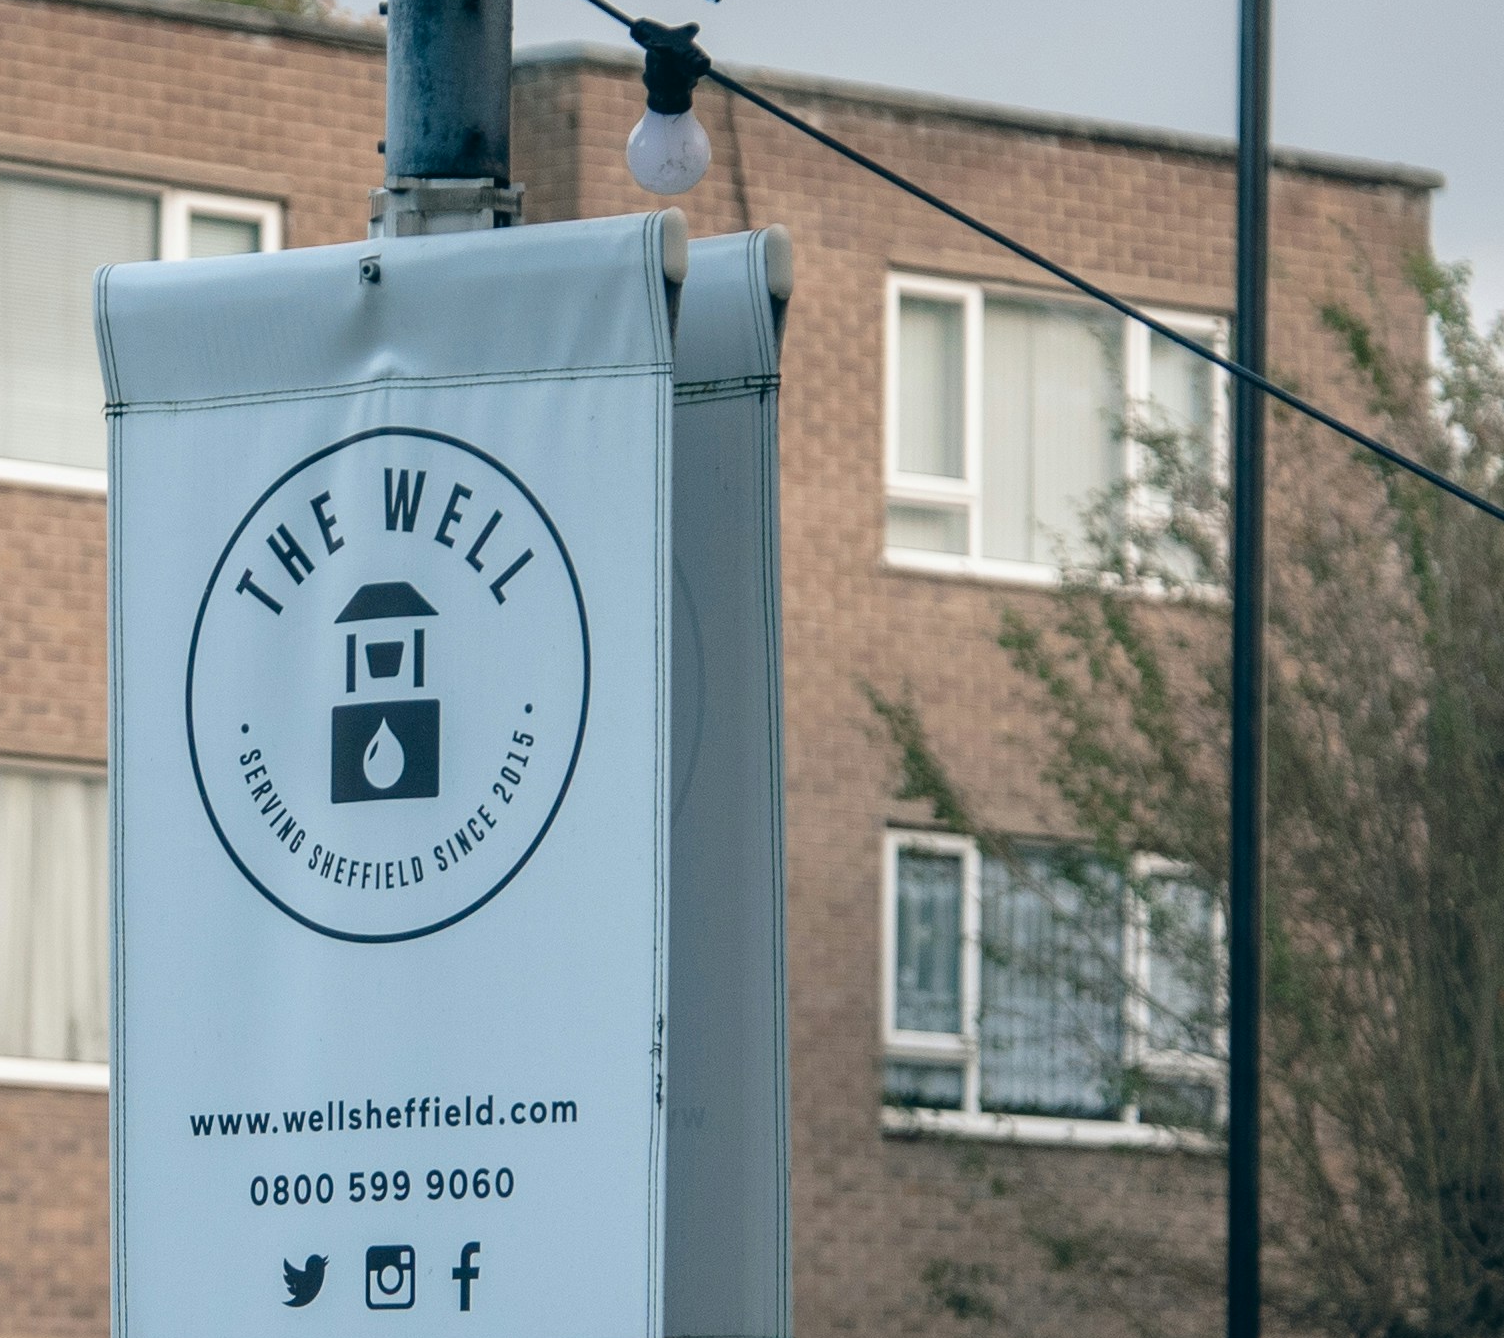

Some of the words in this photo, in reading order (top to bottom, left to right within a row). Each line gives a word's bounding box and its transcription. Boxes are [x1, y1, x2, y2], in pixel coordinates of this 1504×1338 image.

[235, 490, 345, 616] THE
[384, 467, 535, 606] WELL
[239, 748, 306, 854] SERVING
[307, 844, 424, 890] SHEFFIELD
[433, 804, 497, 872] SINCE
[492, 730, 534, 805] 2015
[189, 1094, 578, 1137] www.wellsheffield.com
[250, 1172, 334, 1207] 0800
[349, 1169, 411, 1203] 599
[425, 1167, 515, 1201] 9060
